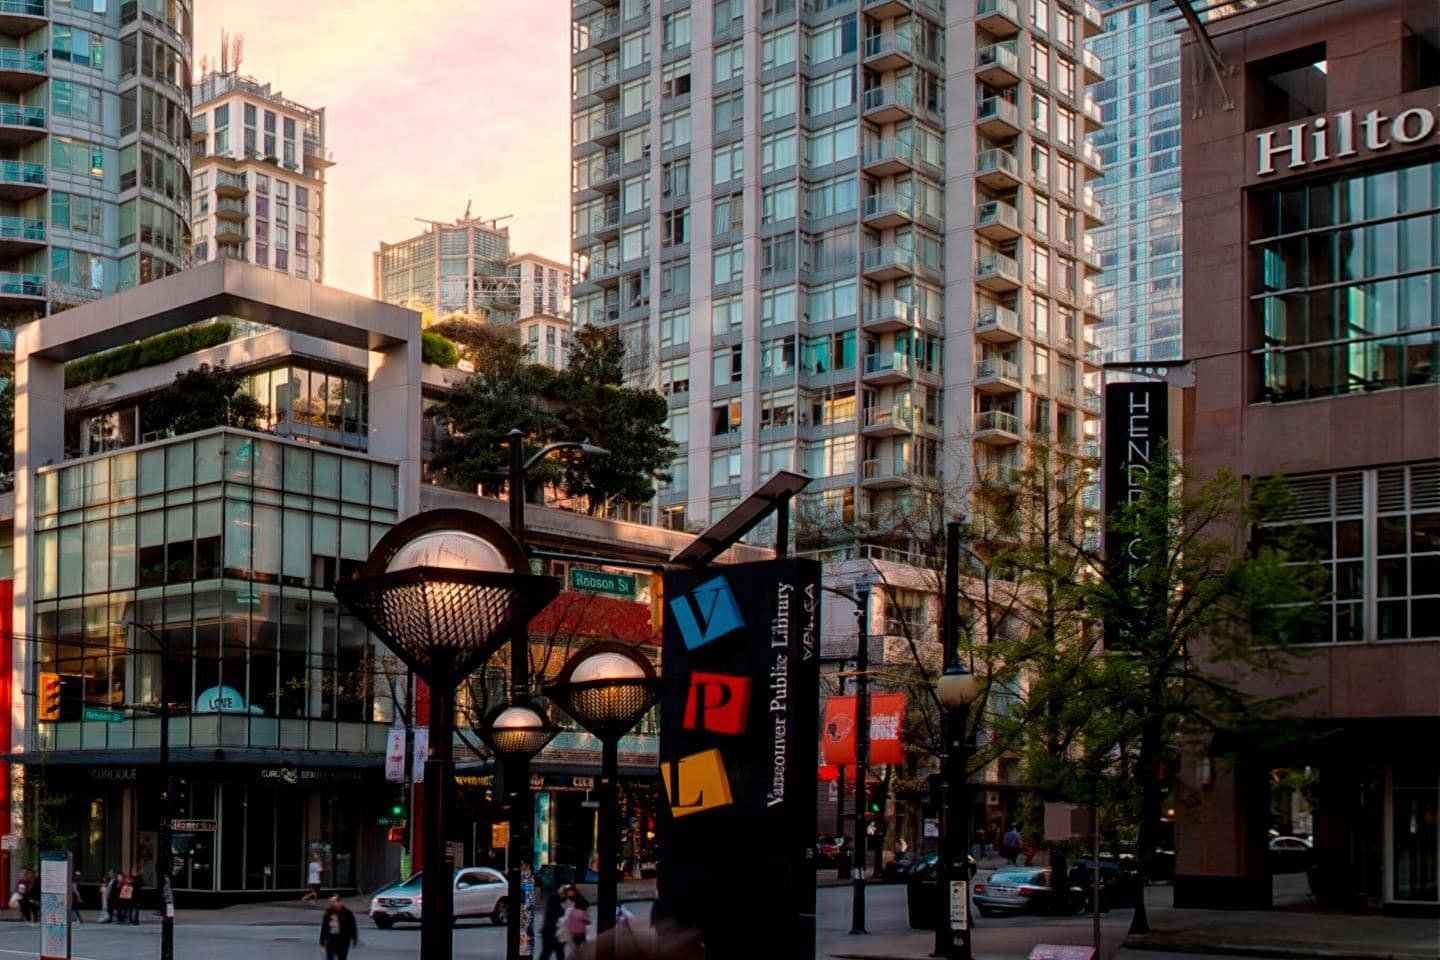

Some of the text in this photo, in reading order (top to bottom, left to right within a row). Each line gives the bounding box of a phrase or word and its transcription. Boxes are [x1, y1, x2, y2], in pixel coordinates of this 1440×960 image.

[1256, 105, 1440, 176] Hilto
[575, 573, 630, 592] Robson St
[766, 582, 794, 808] Vancouver Public Library
